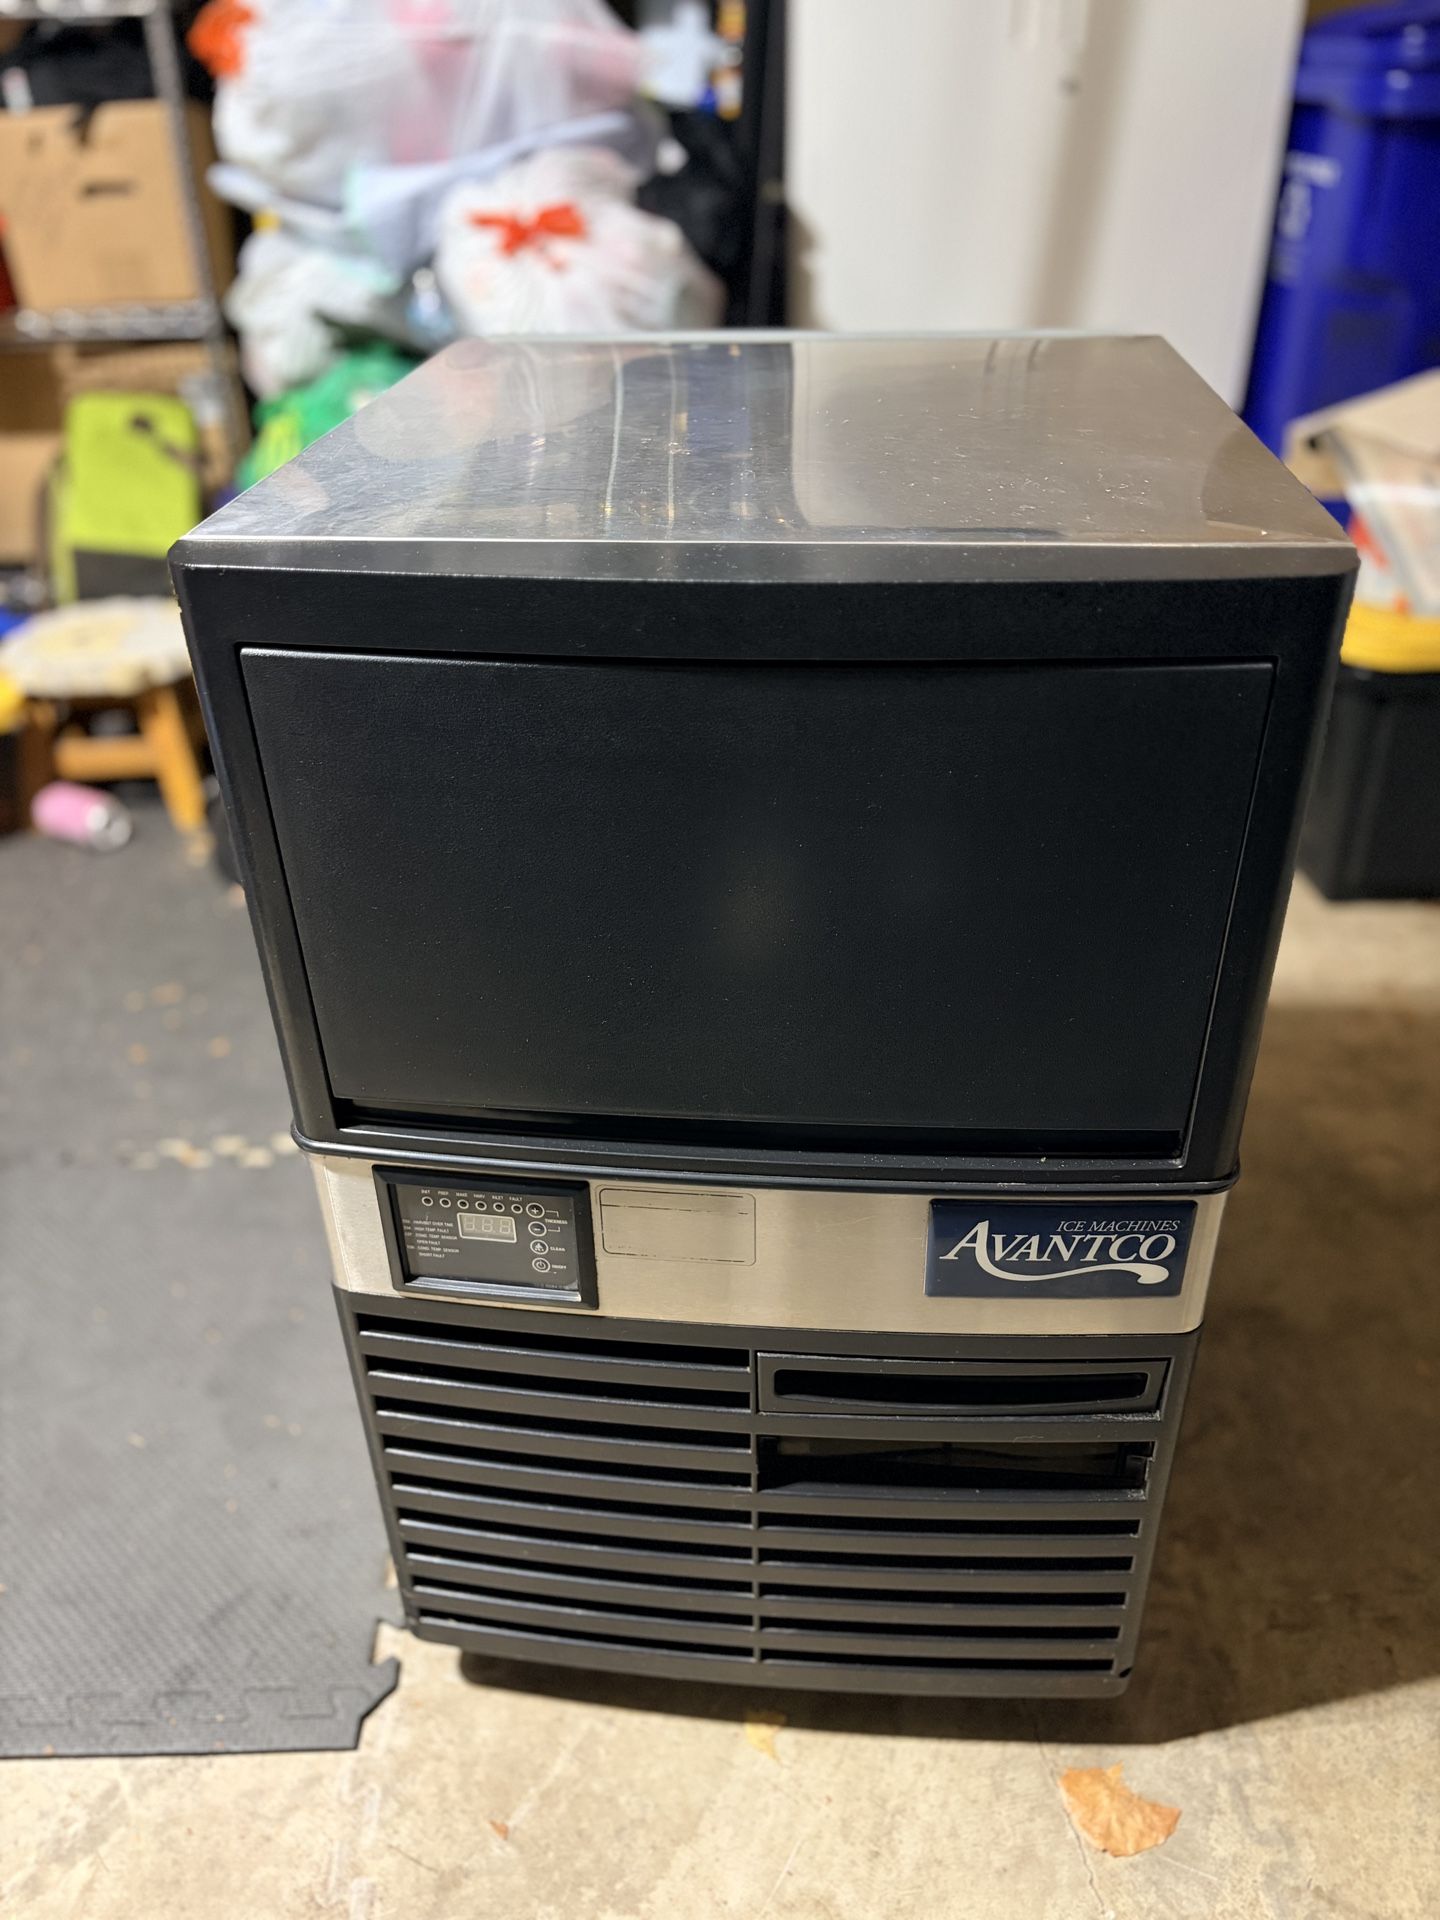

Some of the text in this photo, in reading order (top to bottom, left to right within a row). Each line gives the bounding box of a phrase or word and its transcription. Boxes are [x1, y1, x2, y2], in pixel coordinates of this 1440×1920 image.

[1056, 1220, 1181, 1232] ICE MACHINES
[938, 1219, 1176, 1284] AVANTCO
